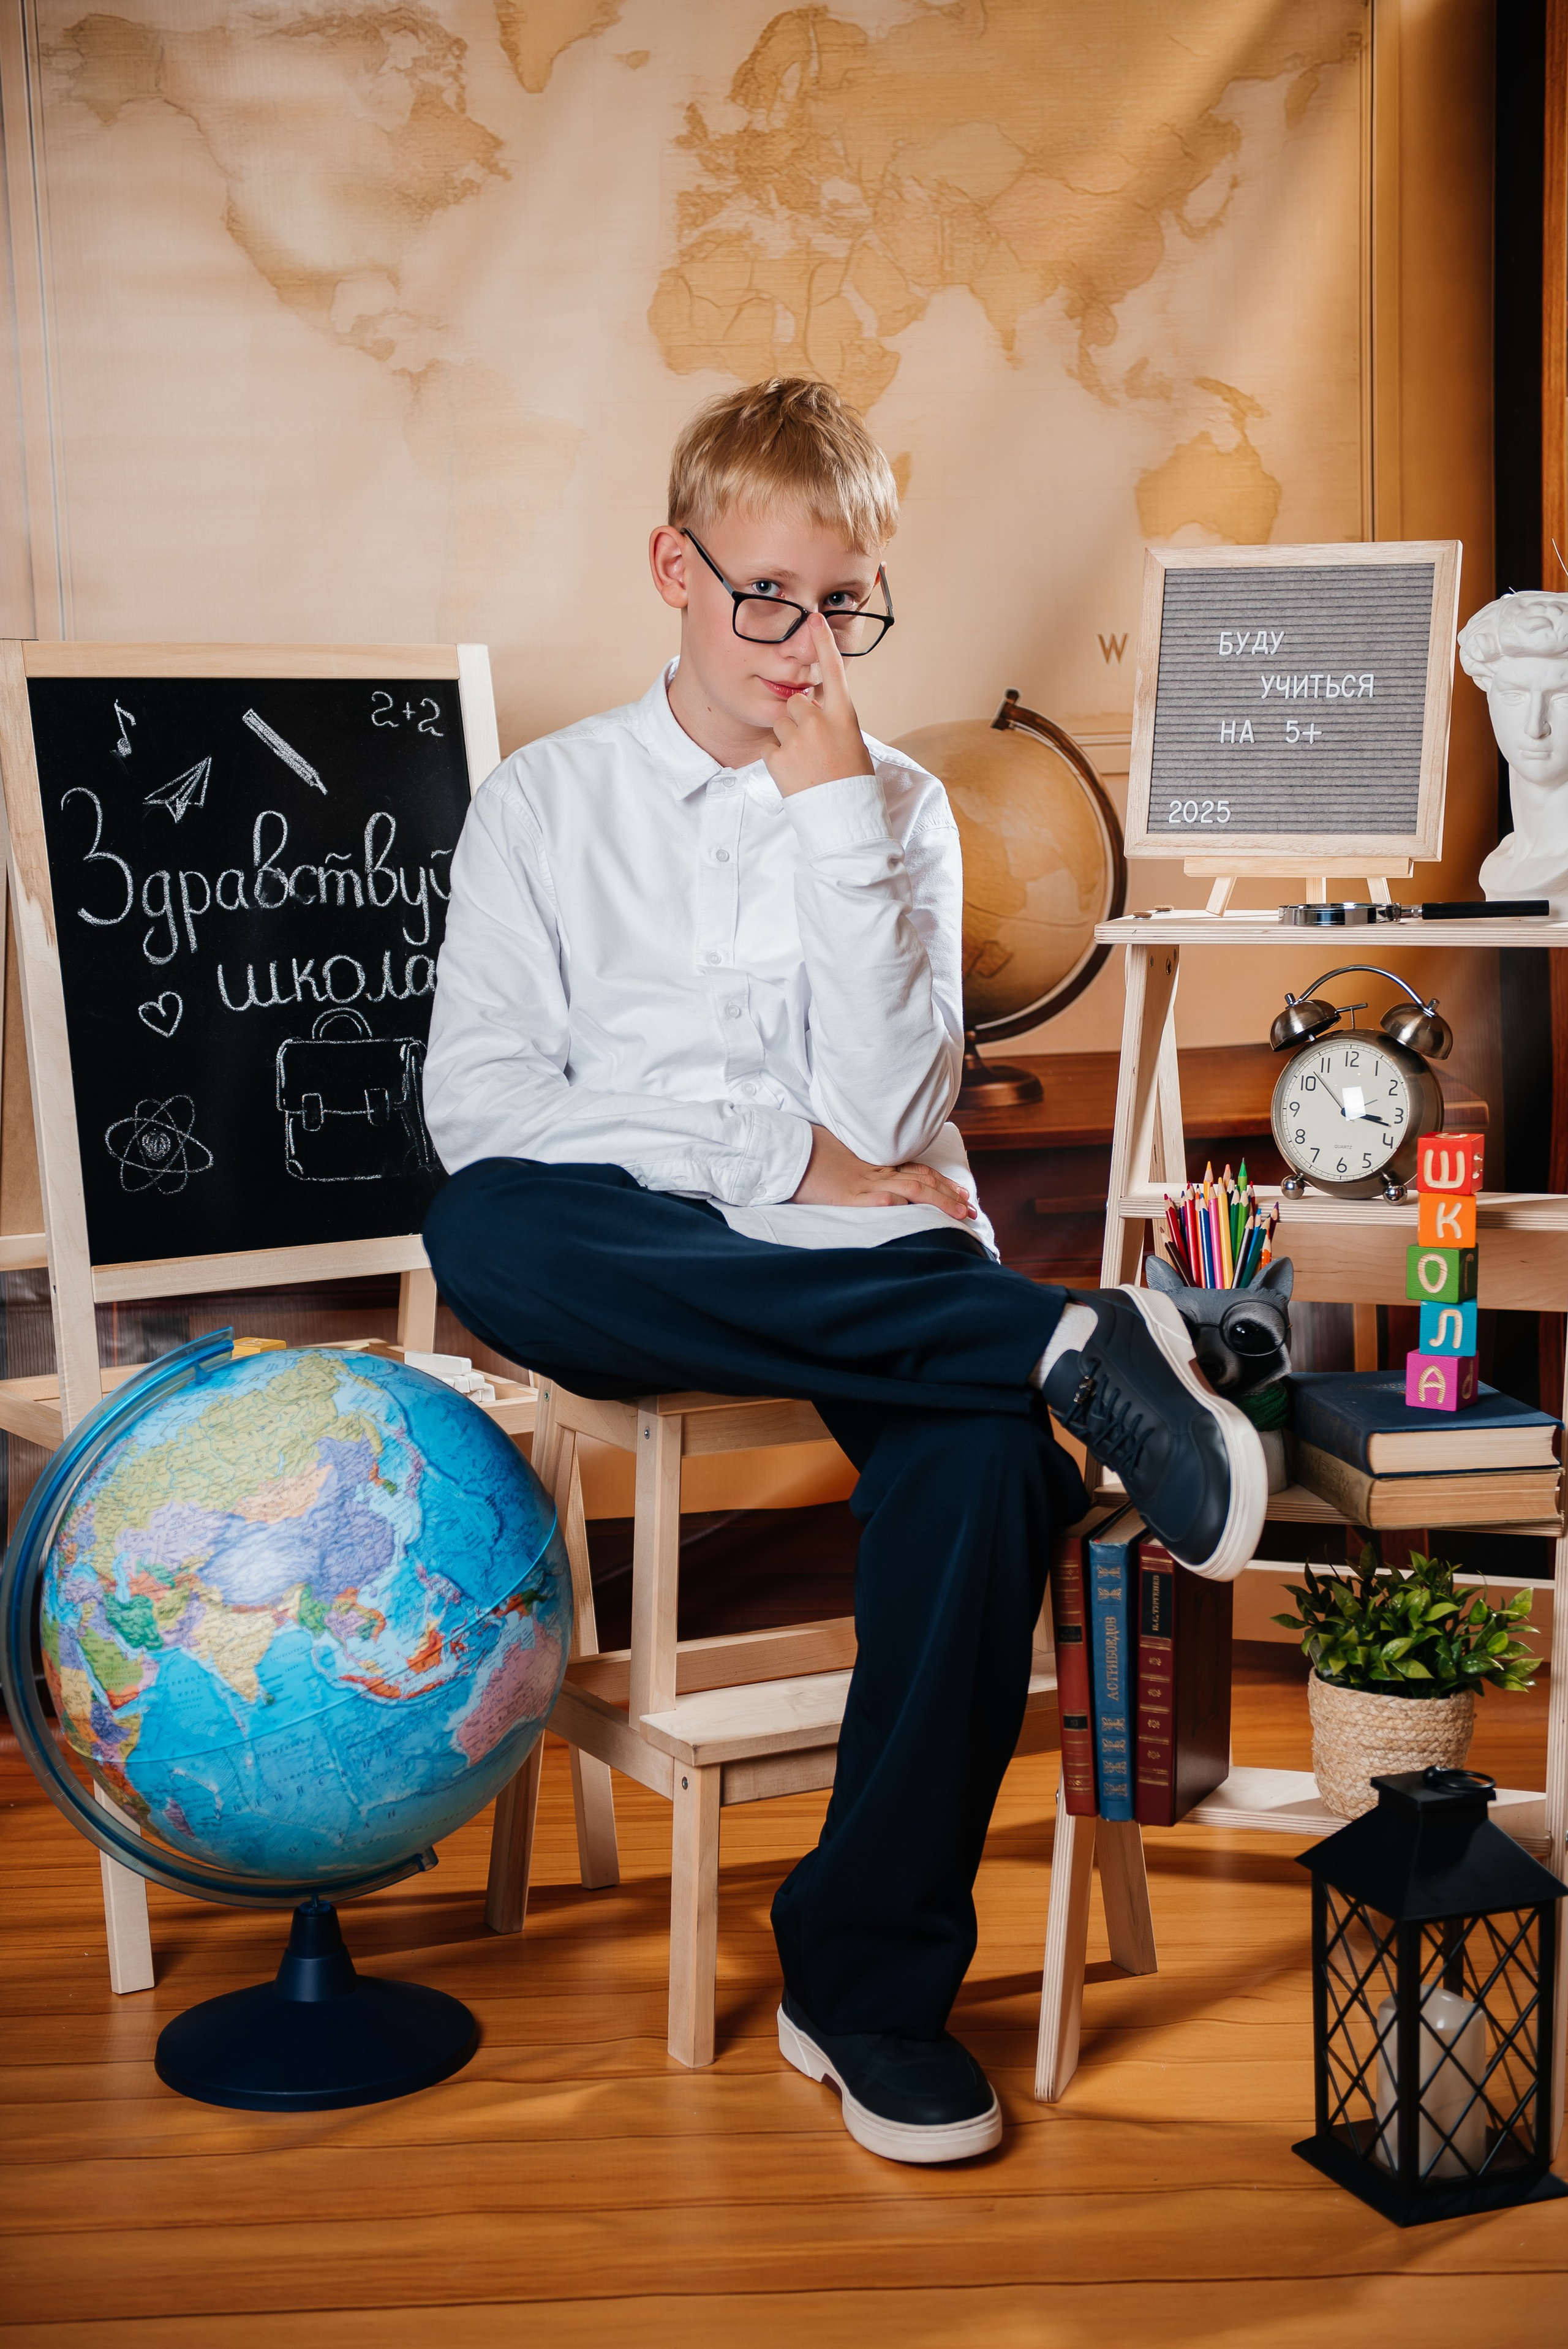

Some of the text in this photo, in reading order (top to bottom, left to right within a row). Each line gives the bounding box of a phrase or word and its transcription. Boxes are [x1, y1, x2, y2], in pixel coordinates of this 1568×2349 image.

[1097, 633, 1129, 665] W
[1219, 630, 1285, 655] БУДУ
[1261, 674, 1375, 699] УЧИТЬСЯ
[371, 691, 443, 737] 2+2
[1220, 720, 1323, 745] НА 5+
[1169, 800, 1231, 823] 2025
[1321, 1057, 1330, 1073] 11
[1345, 1051, 1359, 1067] 12
[1375, 1060, 1378, 1076] 1
[1300, 1075, 1316, 1092] 10
[1389, 1079, 1398, 1096] 2
[1289, 1101, 1300, 1118] 9
[1394, 1107, 1404, 1124] 3
[1295, 1129, 1305, 1144] 8
[1382, 1133, 1394, 1149] 4
[1310, 1147, 1321, 1163] 7
[1362, 1153, 1371, 1168] 5
[1336, 1157, 1347, 1173] 6
